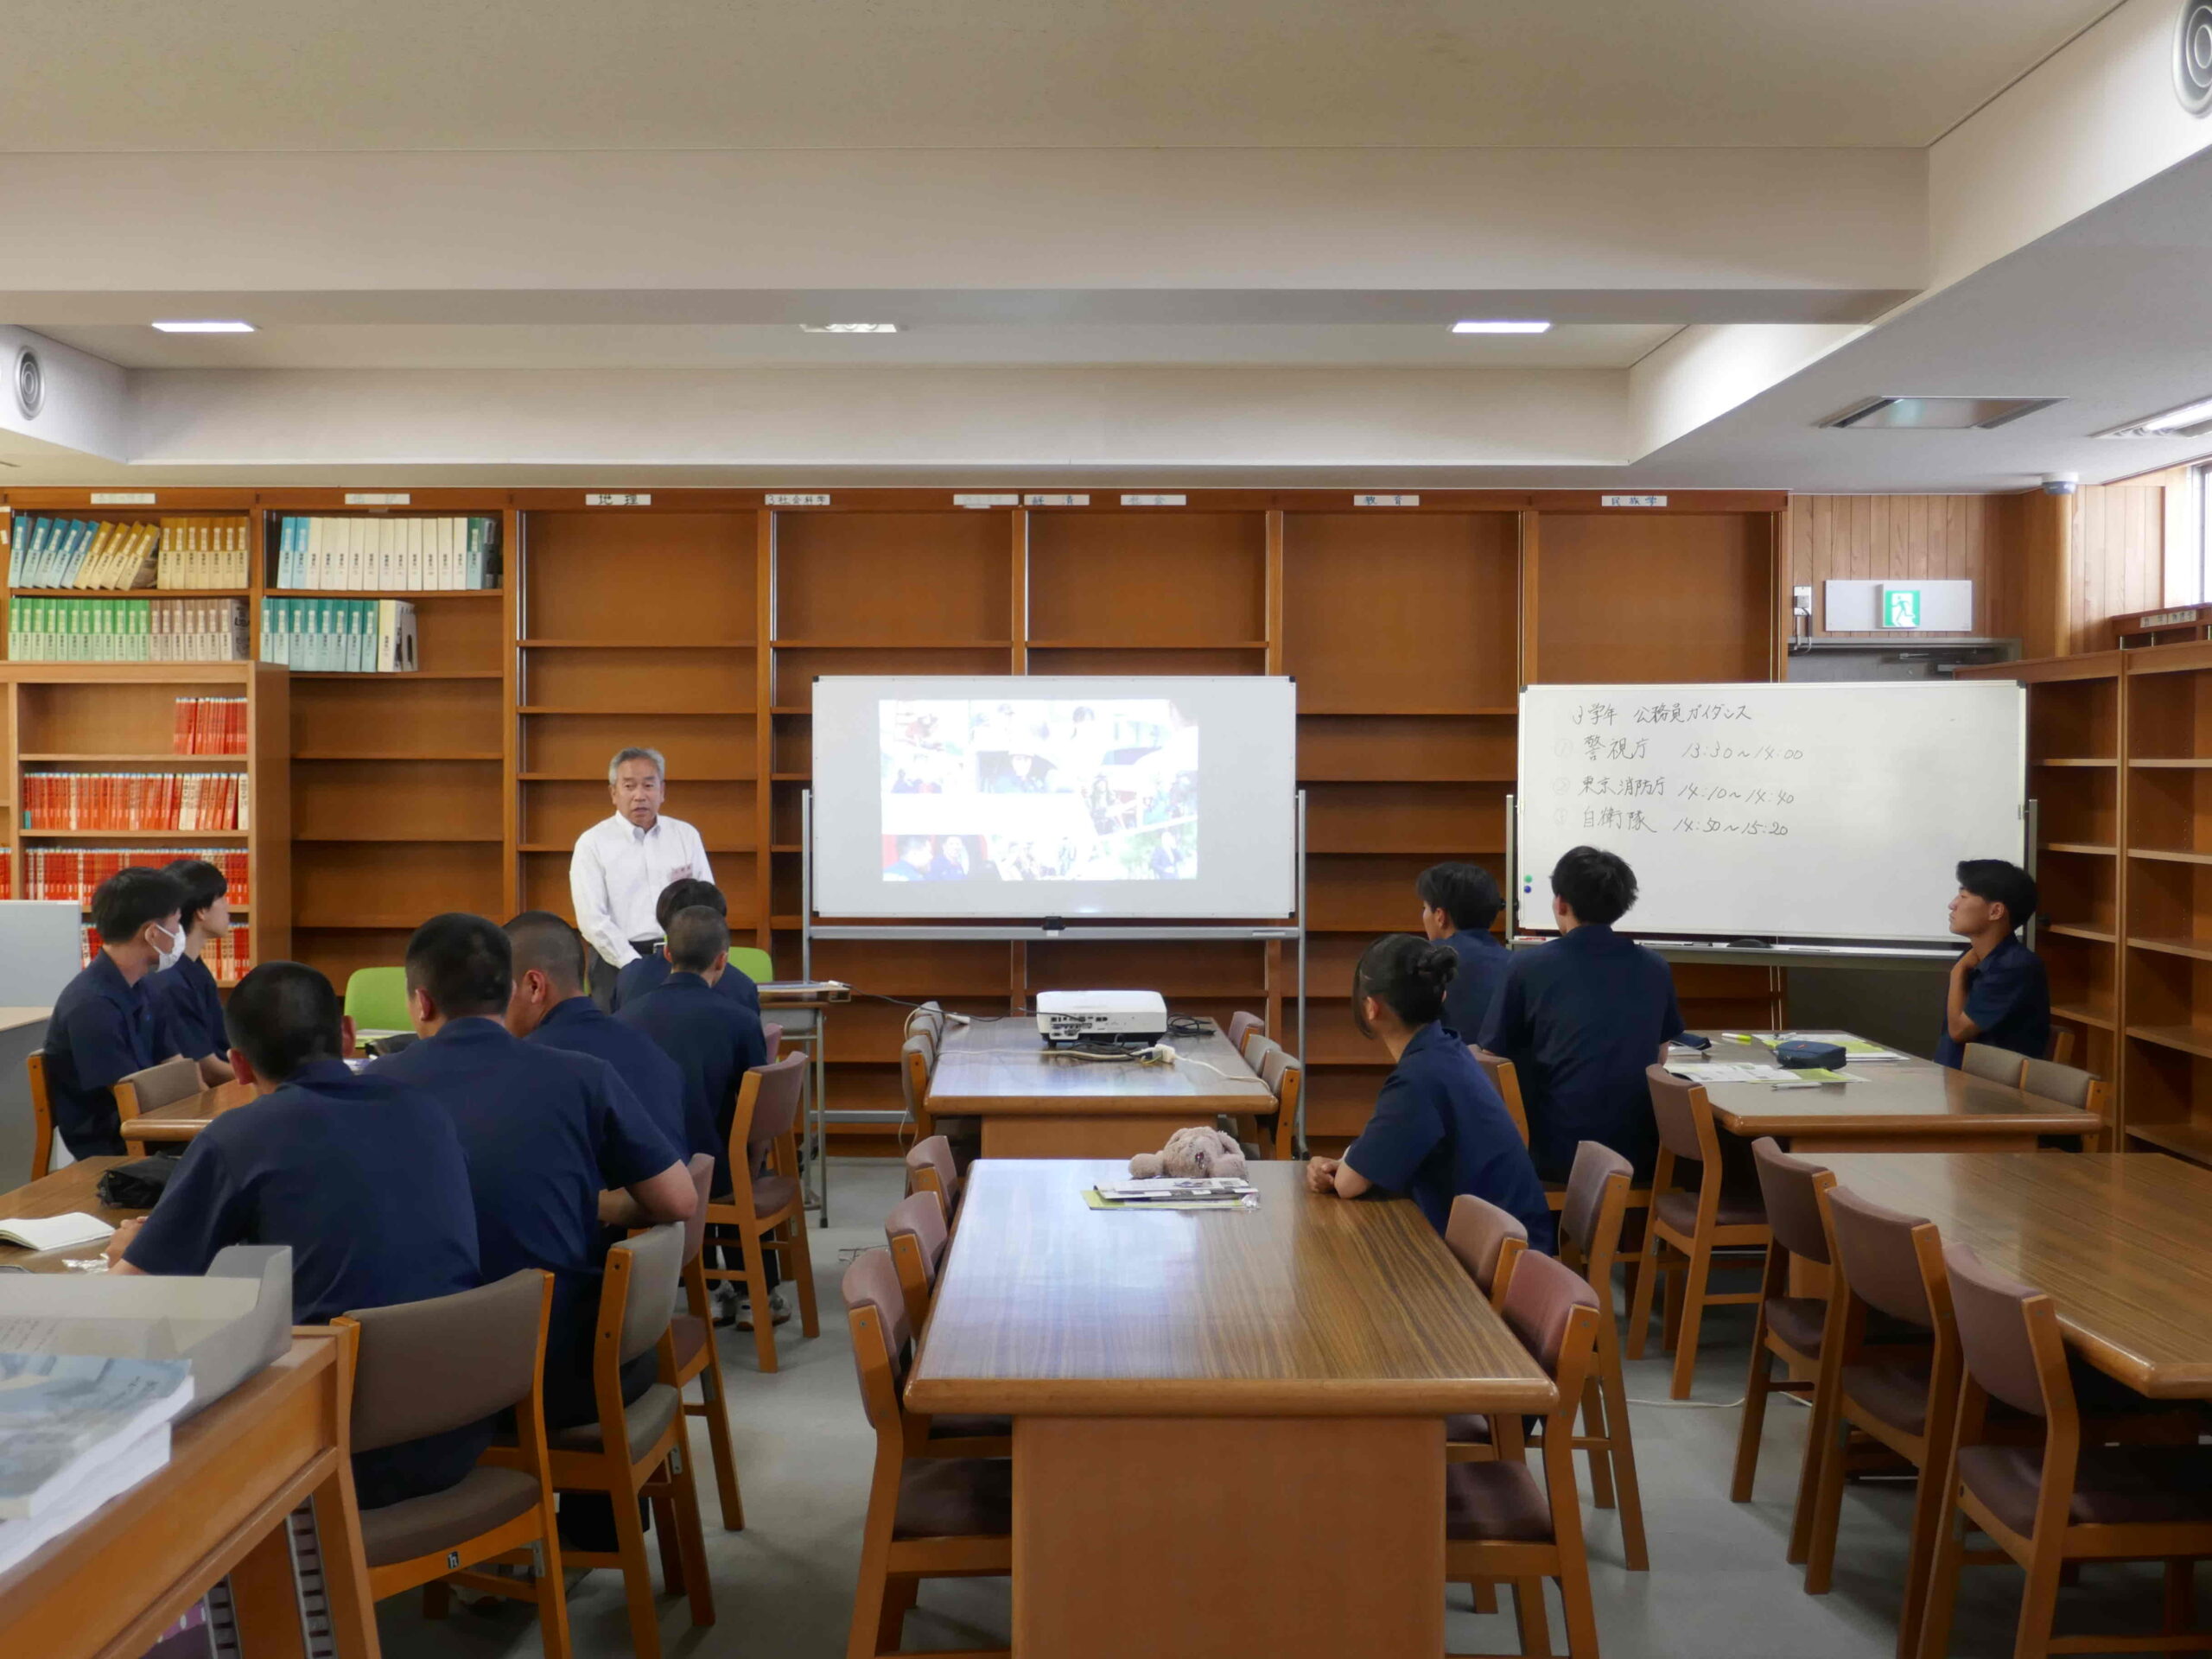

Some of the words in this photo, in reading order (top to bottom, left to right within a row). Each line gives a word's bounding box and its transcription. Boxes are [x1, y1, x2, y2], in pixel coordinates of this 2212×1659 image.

[1573, 702, 1618, 726] 3学年
[1633, 702, 1752, 724] 公務員ガイダンス
[1584, 734, 1649, 761] 警視庁
[1578, 775, 1666, 798] 東京消防庁
[1583, 805, 1657, 834] 自衛隊
